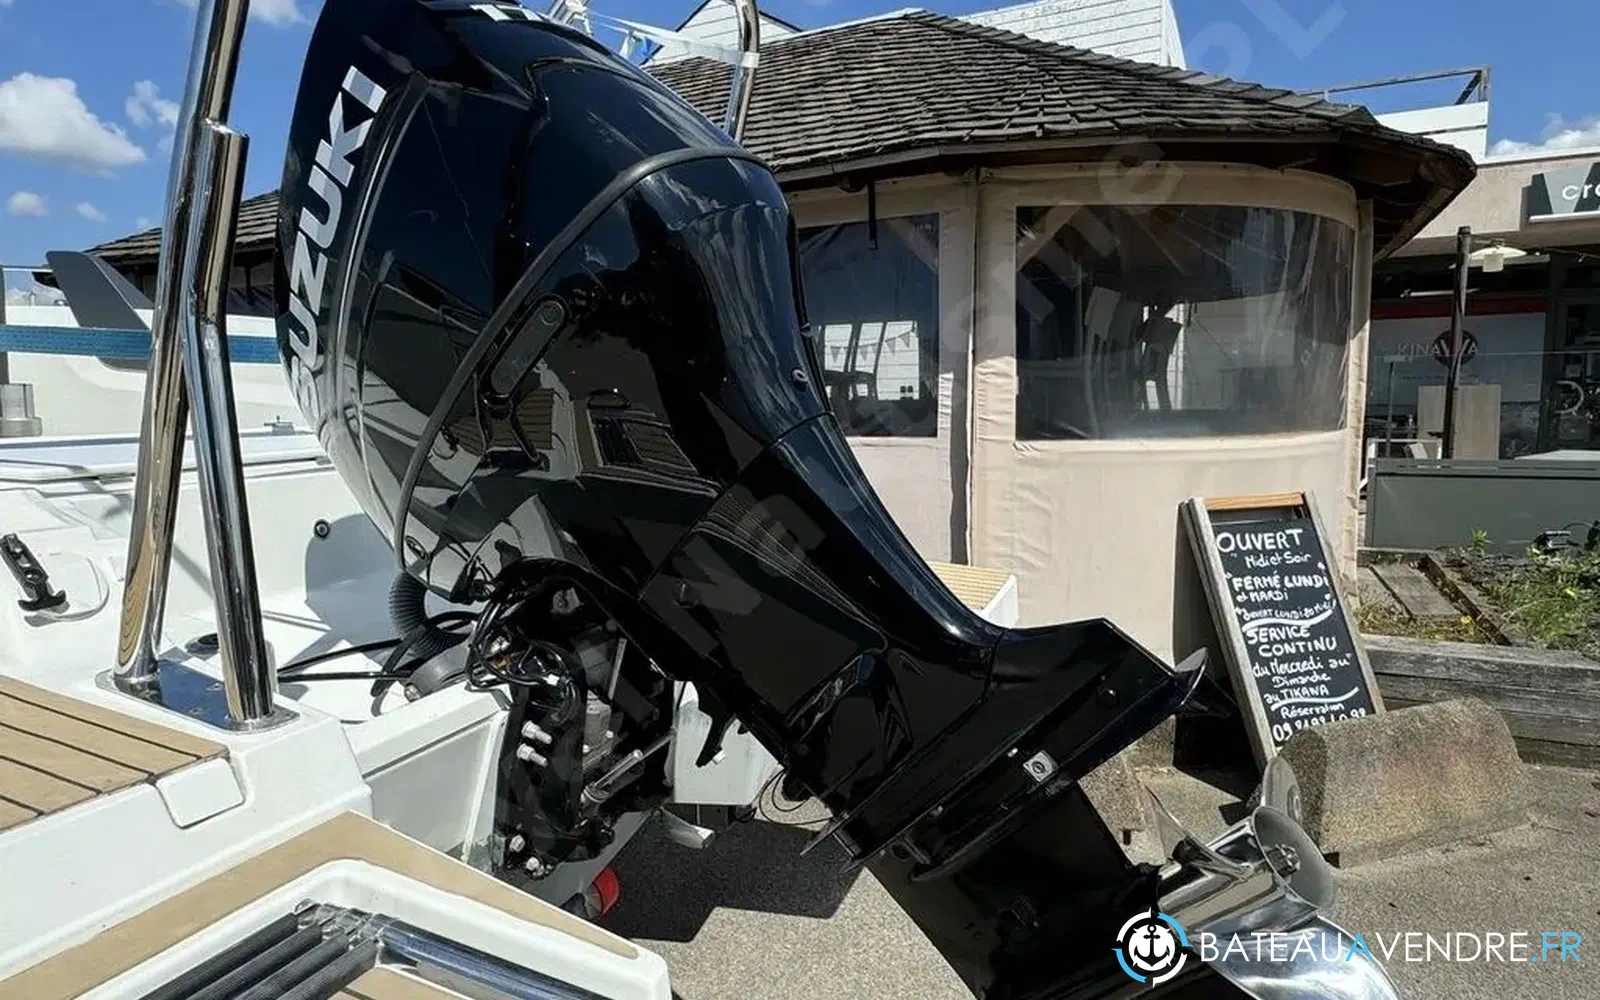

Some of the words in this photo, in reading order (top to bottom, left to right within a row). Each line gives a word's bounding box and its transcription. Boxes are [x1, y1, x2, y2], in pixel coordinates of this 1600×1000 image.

[1217, 528, 1303, 553] OUVERT
[1246, 625, 1310, 645] SERVICE
[1258, 636, 1338, 658] CONTINU
